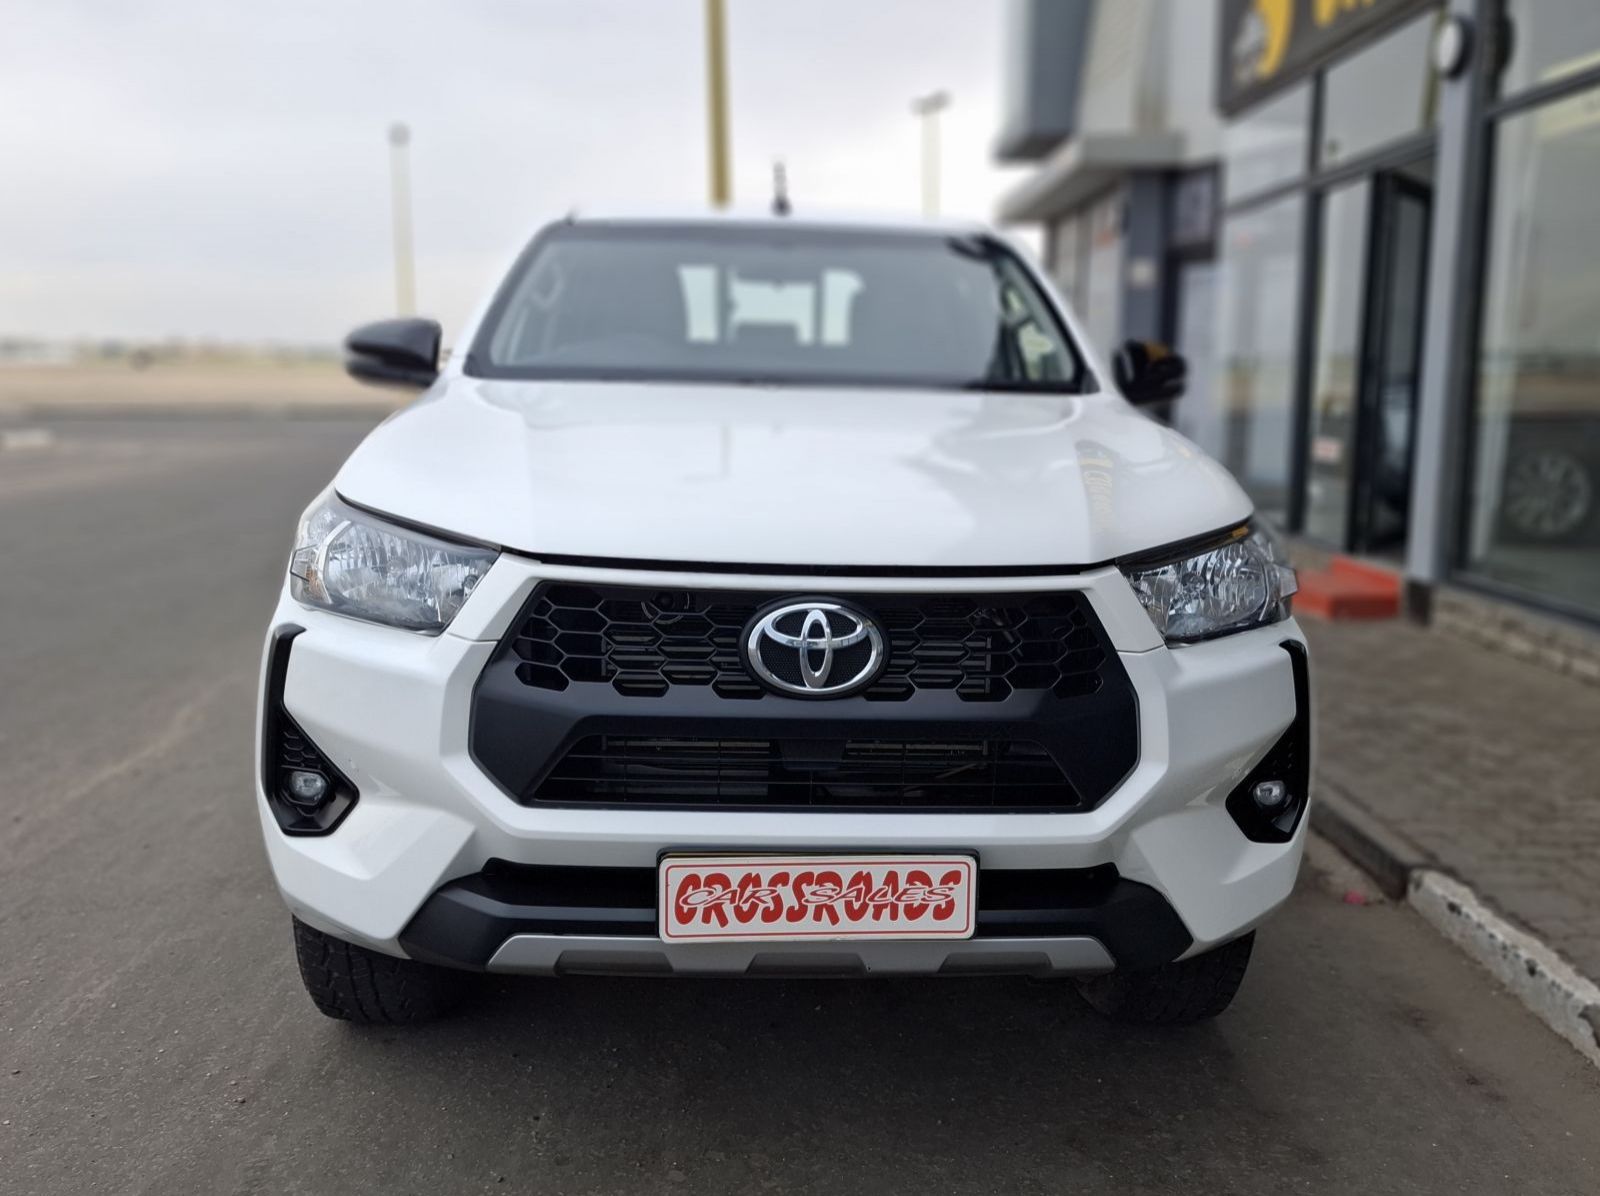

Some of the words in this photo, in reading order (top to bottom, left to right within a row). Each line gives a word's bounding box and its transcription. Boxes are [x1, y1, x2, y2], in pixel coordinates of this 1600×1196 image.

[674, 869, 962, 928] CROSSROADS
[679, 887, 780, 907] CAR
[802, 885, 955, 905] SALES
